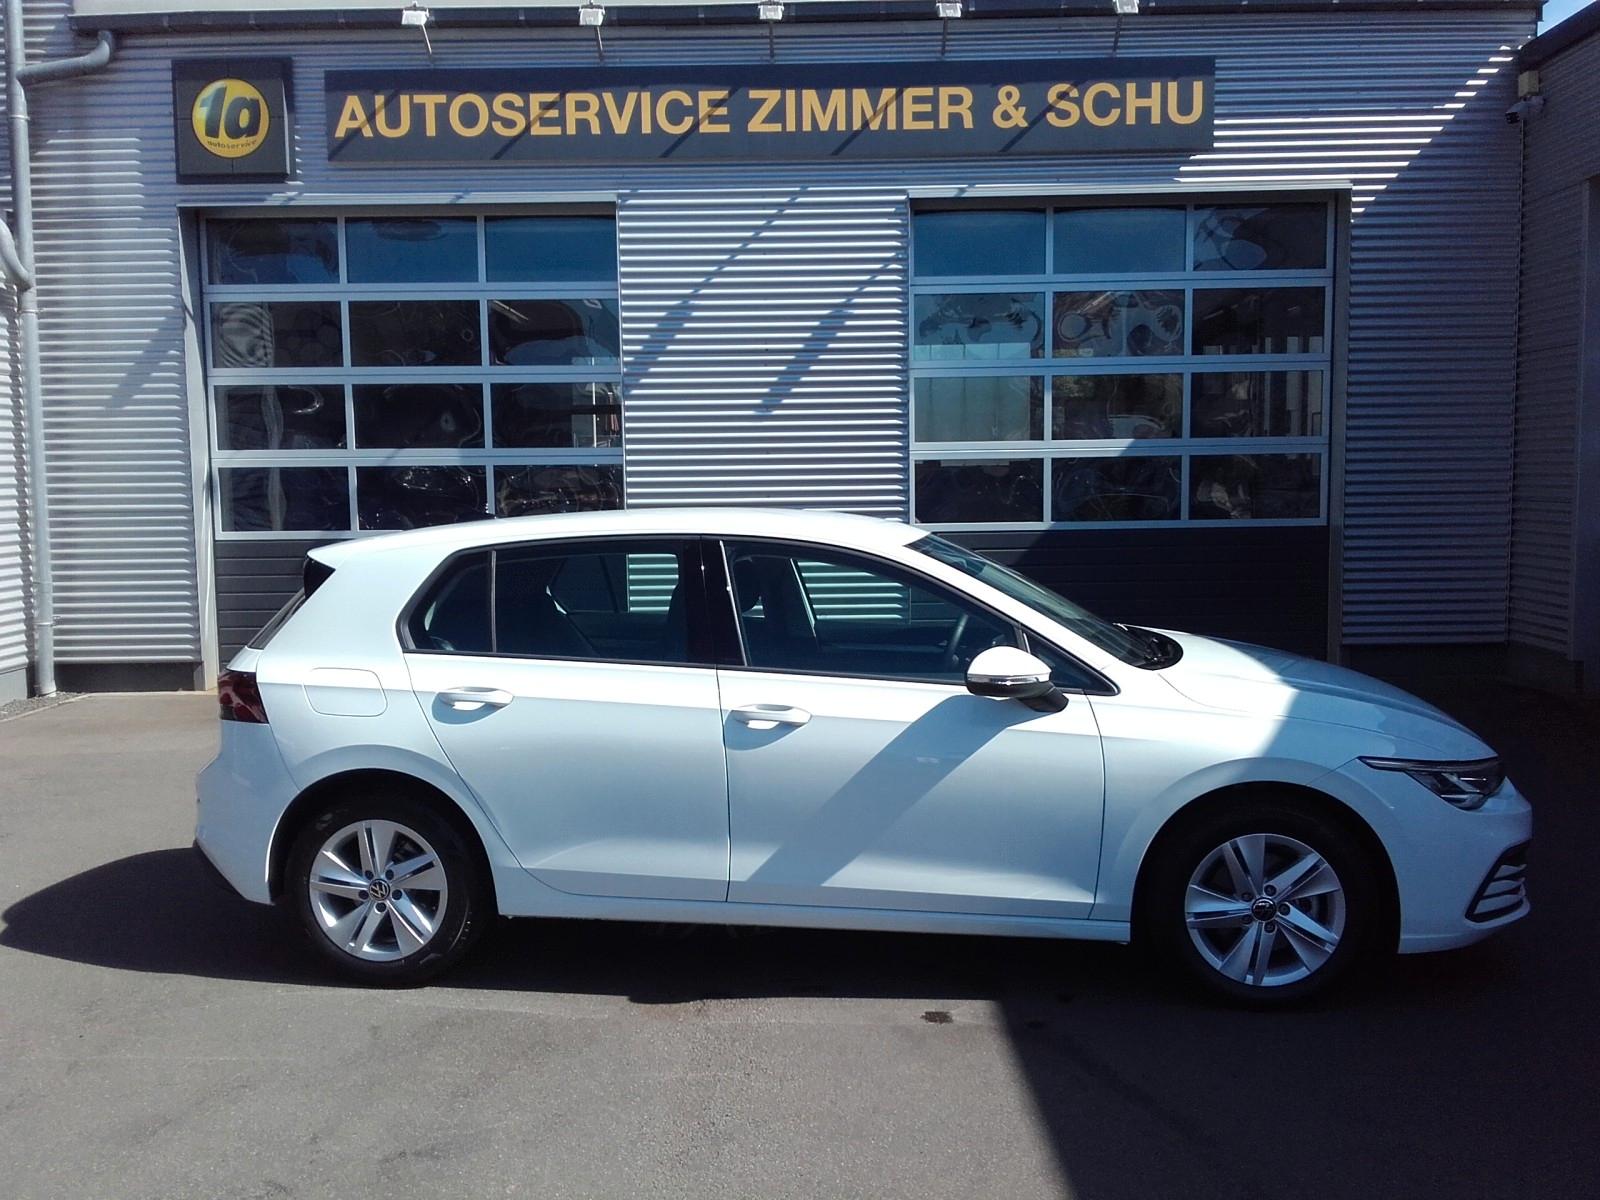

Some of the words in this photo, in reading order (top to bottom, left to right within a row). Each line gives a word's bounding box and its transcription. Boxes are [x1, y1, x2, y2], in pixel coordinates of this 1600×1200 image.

[199, 85, 261, 140] 1a
[334, 90, 730, 138] AUTOSERVICE
[747, 87, 974, 132] ZIMMER
[992, 84, 1029, 128] &
[1046, 80, 1204, 128] SCHU
